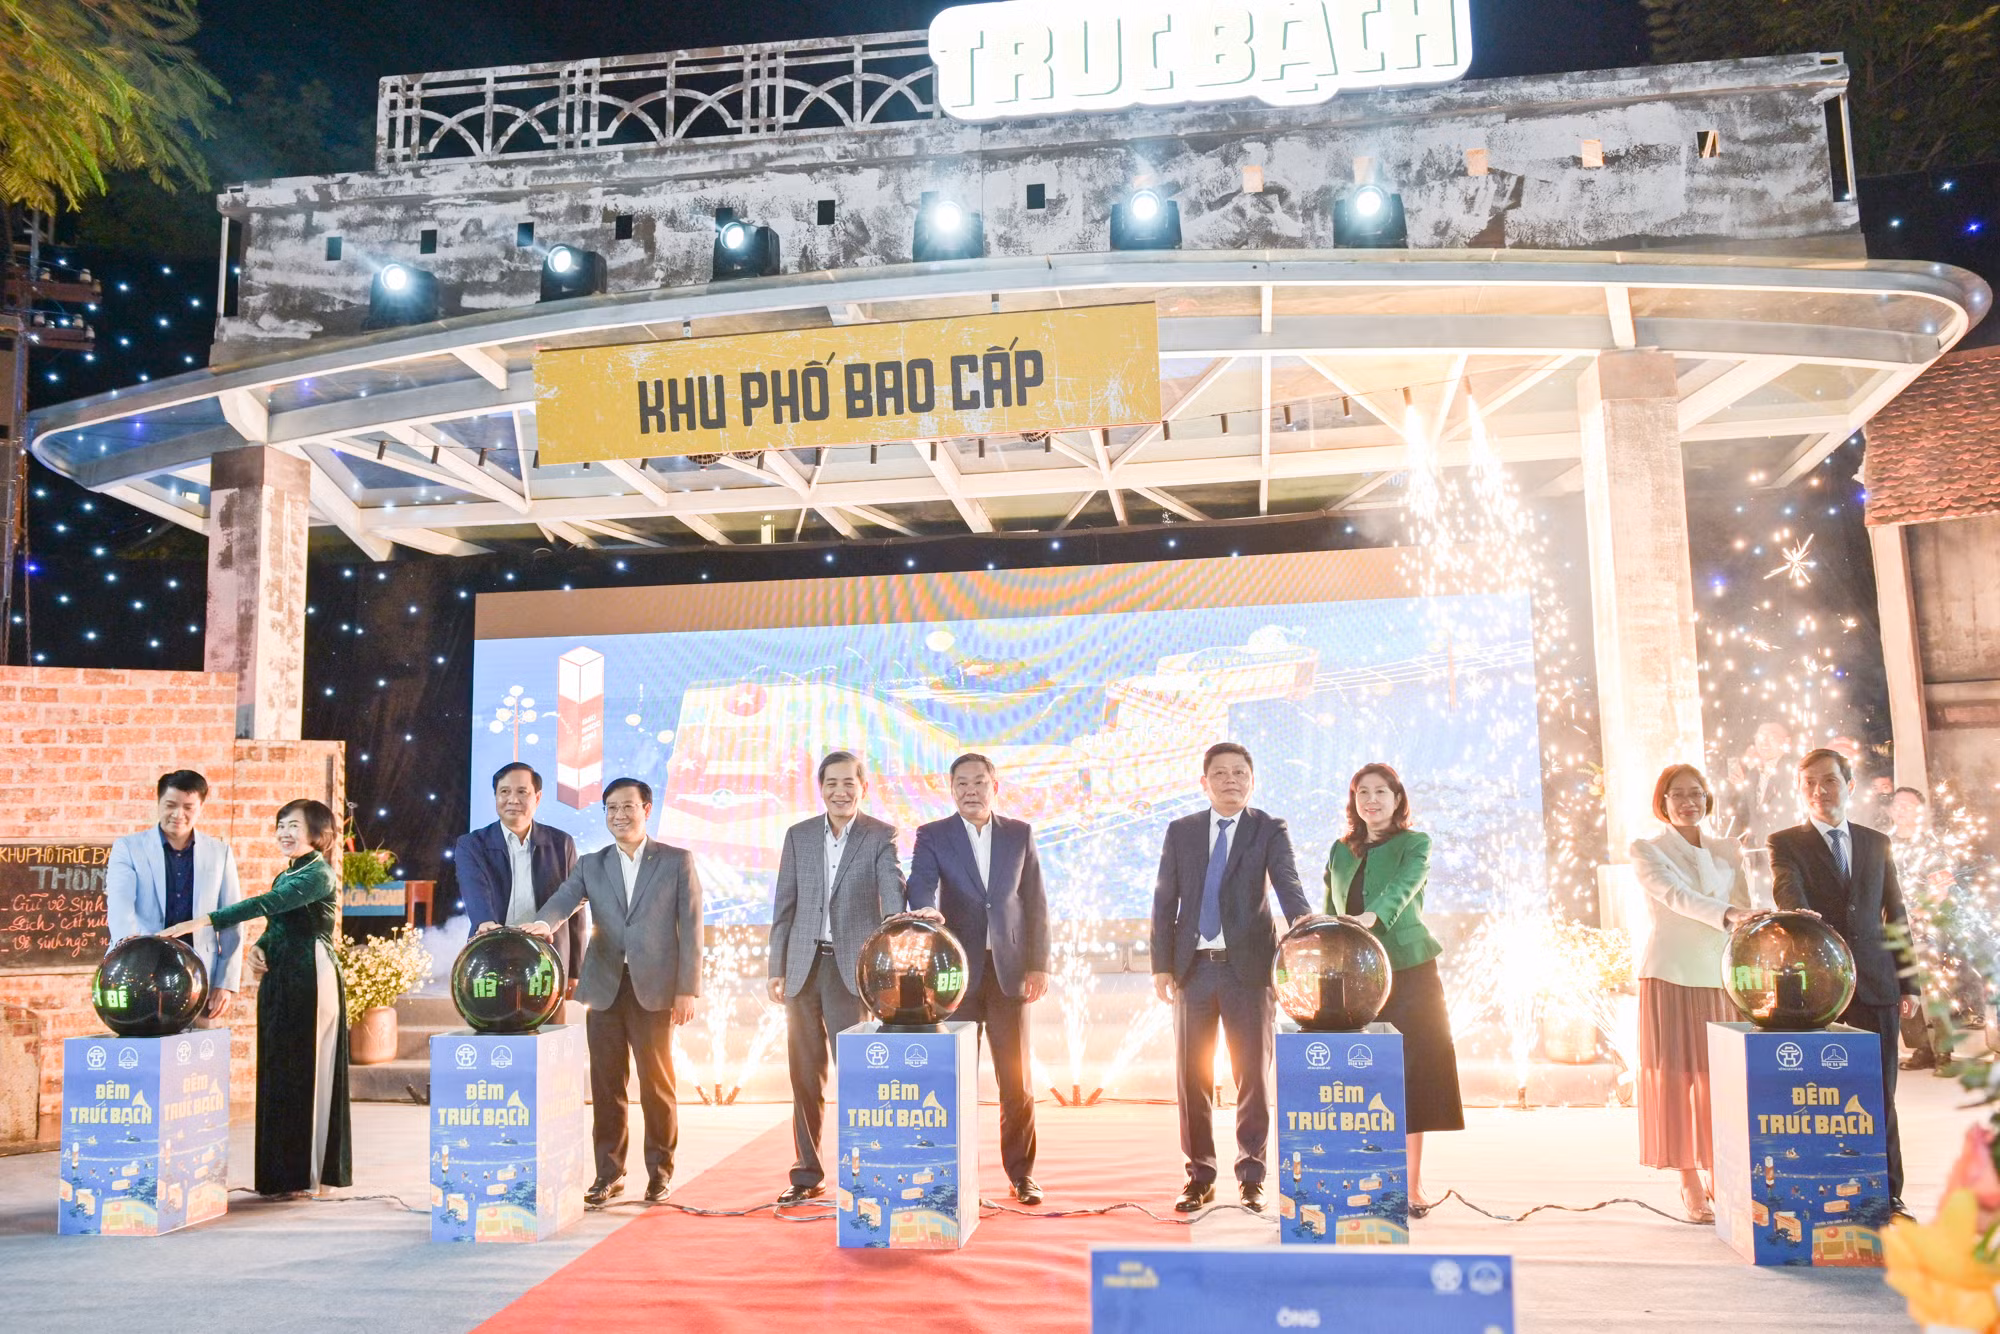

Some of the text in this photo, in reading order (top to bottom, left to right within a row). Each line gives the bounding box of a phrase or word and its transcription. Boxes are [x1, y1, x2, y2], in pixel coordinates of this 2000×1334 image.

[637, 336, 1045, 435] KHU PHỐ BAO CẤP
[0, 847, 26, 864] KHU
[56, 845, 90, 864] TRÚC
[94, 1080, 130, 1100] ĐÊM
[466, 1079, 505, 1101] ĐÊM
[877, 1080, 919, 1101] ĐÊM
[1318, 1081, 1364, 1103] ĐÊM
[1791, 1082, 1840, 1106] ĐÊM
[110, 1107, 152, 1127] BẠCH
[483, 1108, 530, 1129] BẠCH
[848, 1101, 948, 1130] TRÚC BẠCH
[1287, 1104, 1396, 1134] TRÚC BẠCH
[1758, 1107, 1874, 1138] TRÚC BẠCH
